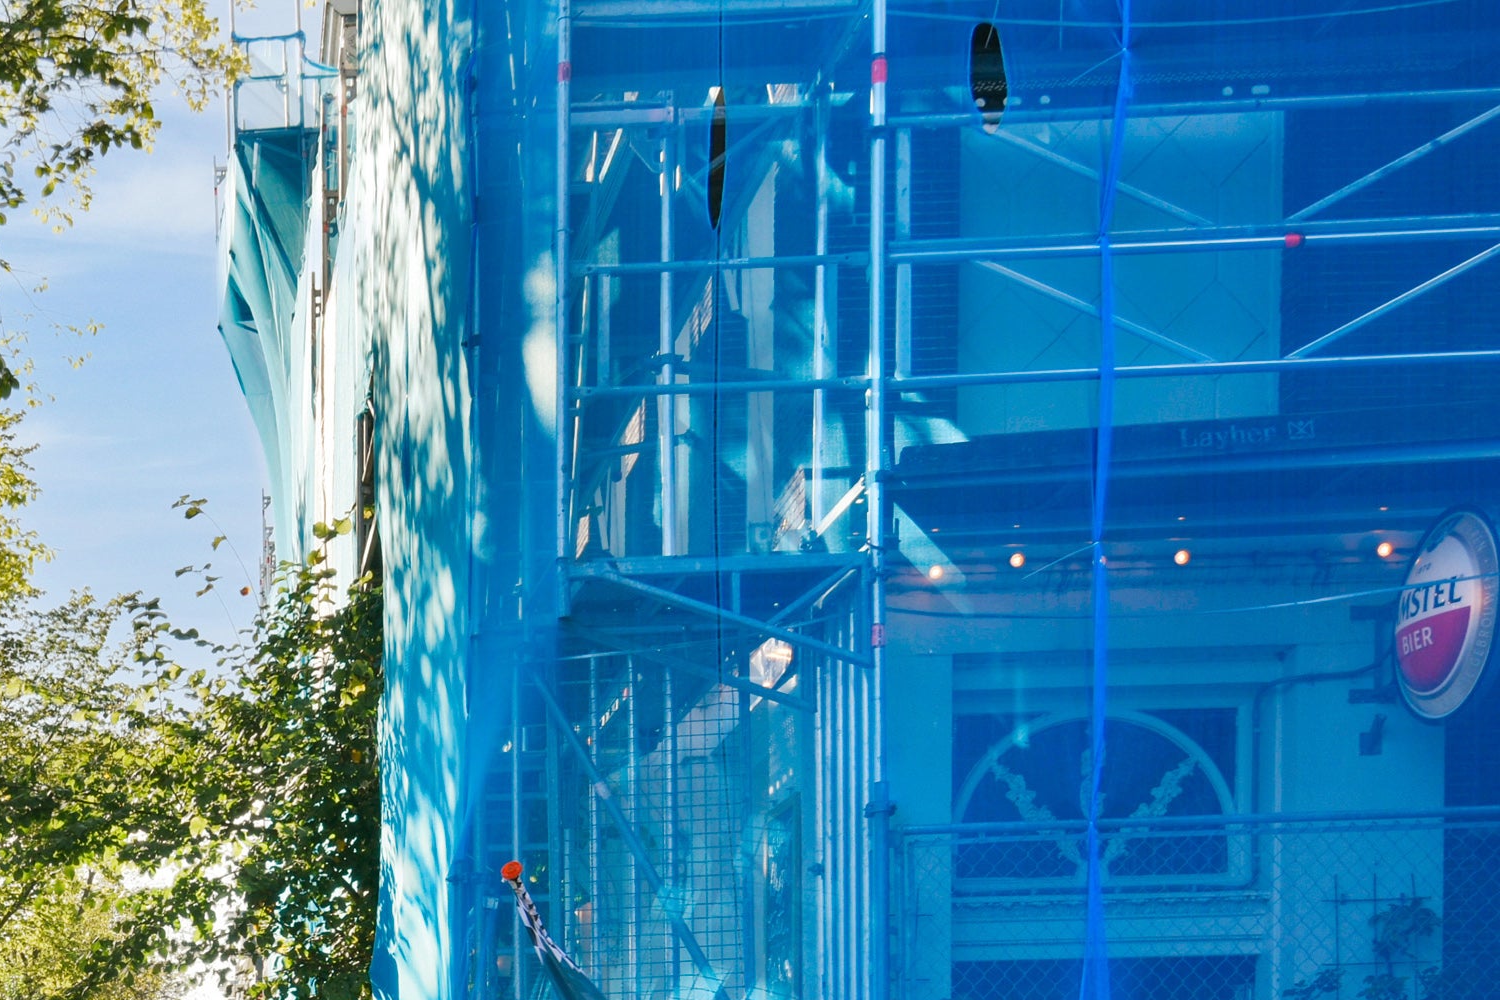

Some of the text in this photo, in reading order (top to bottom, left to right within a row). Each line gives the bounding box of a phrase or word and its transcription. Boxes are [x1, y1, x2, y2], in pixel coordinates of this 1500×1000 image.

[1179, 425, 1276, 448] Layher
[1397, 575, 1463, 626] MSTEL
[1402, 626, 1434, 656] BIER
